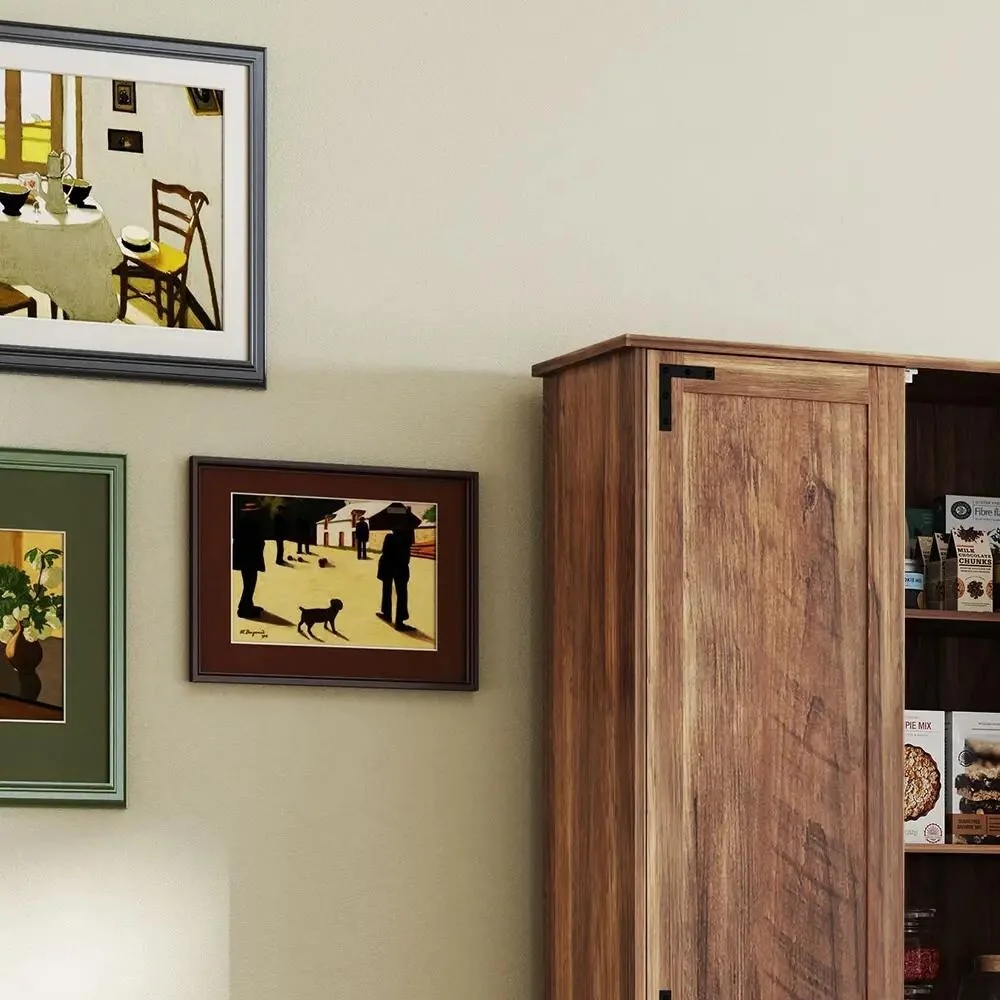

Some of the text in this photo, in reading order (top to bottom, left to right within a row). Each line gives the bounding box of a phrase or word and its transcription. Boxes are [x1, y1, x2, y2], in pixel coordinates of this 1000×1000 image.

[974, 507, 992, 516] Fibre
[905, 721, 932, 730] PIE MIX
